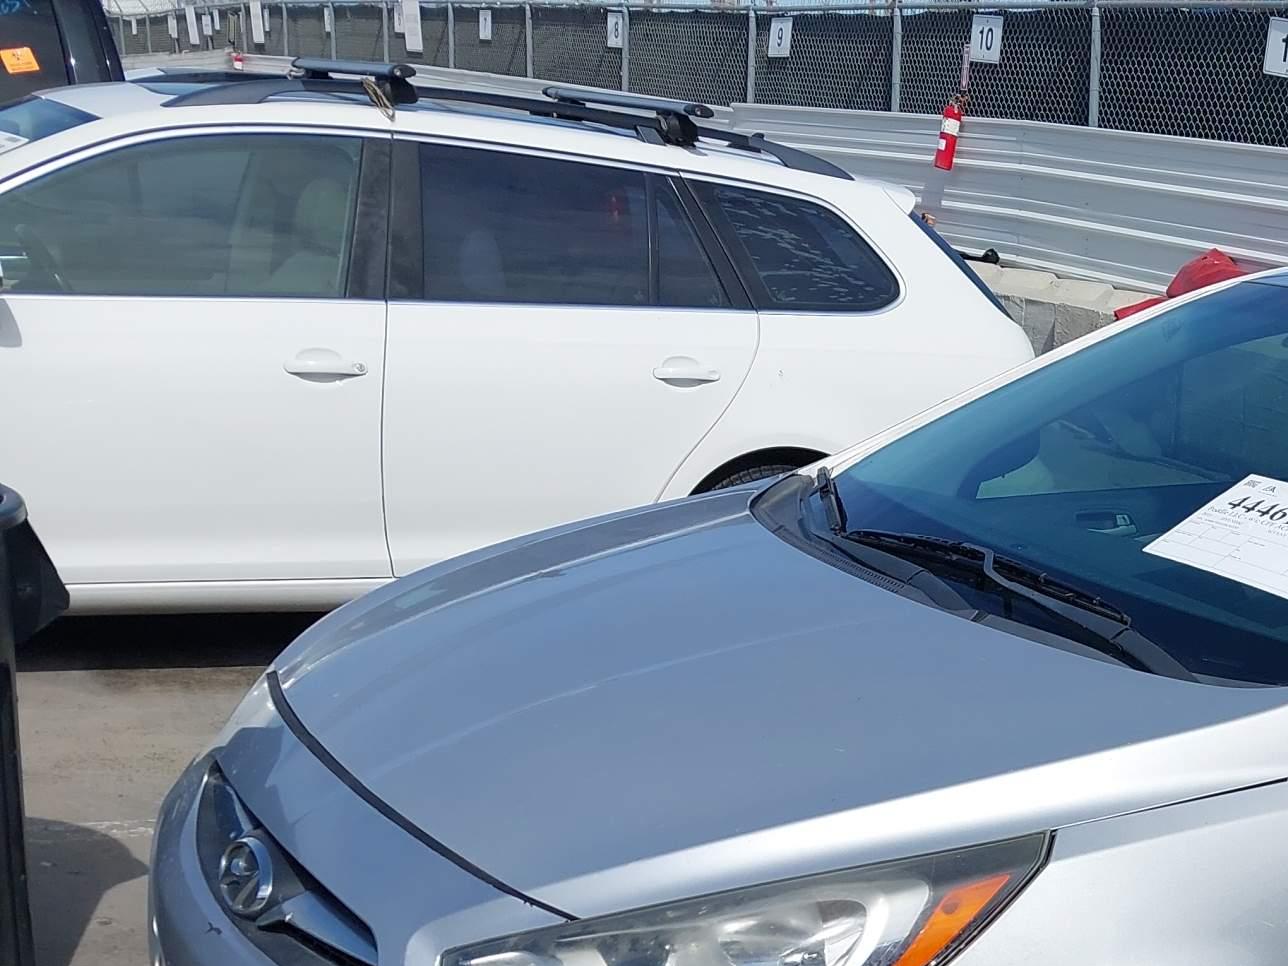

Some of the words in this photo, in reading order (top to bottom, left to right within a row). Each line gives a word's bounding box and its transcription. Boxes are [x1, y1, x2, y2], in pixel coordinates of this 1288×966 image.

[613, 21, 620, 39] 8
[776, 27, 784, 48] 9
[978, 26, 995, 51] 10
